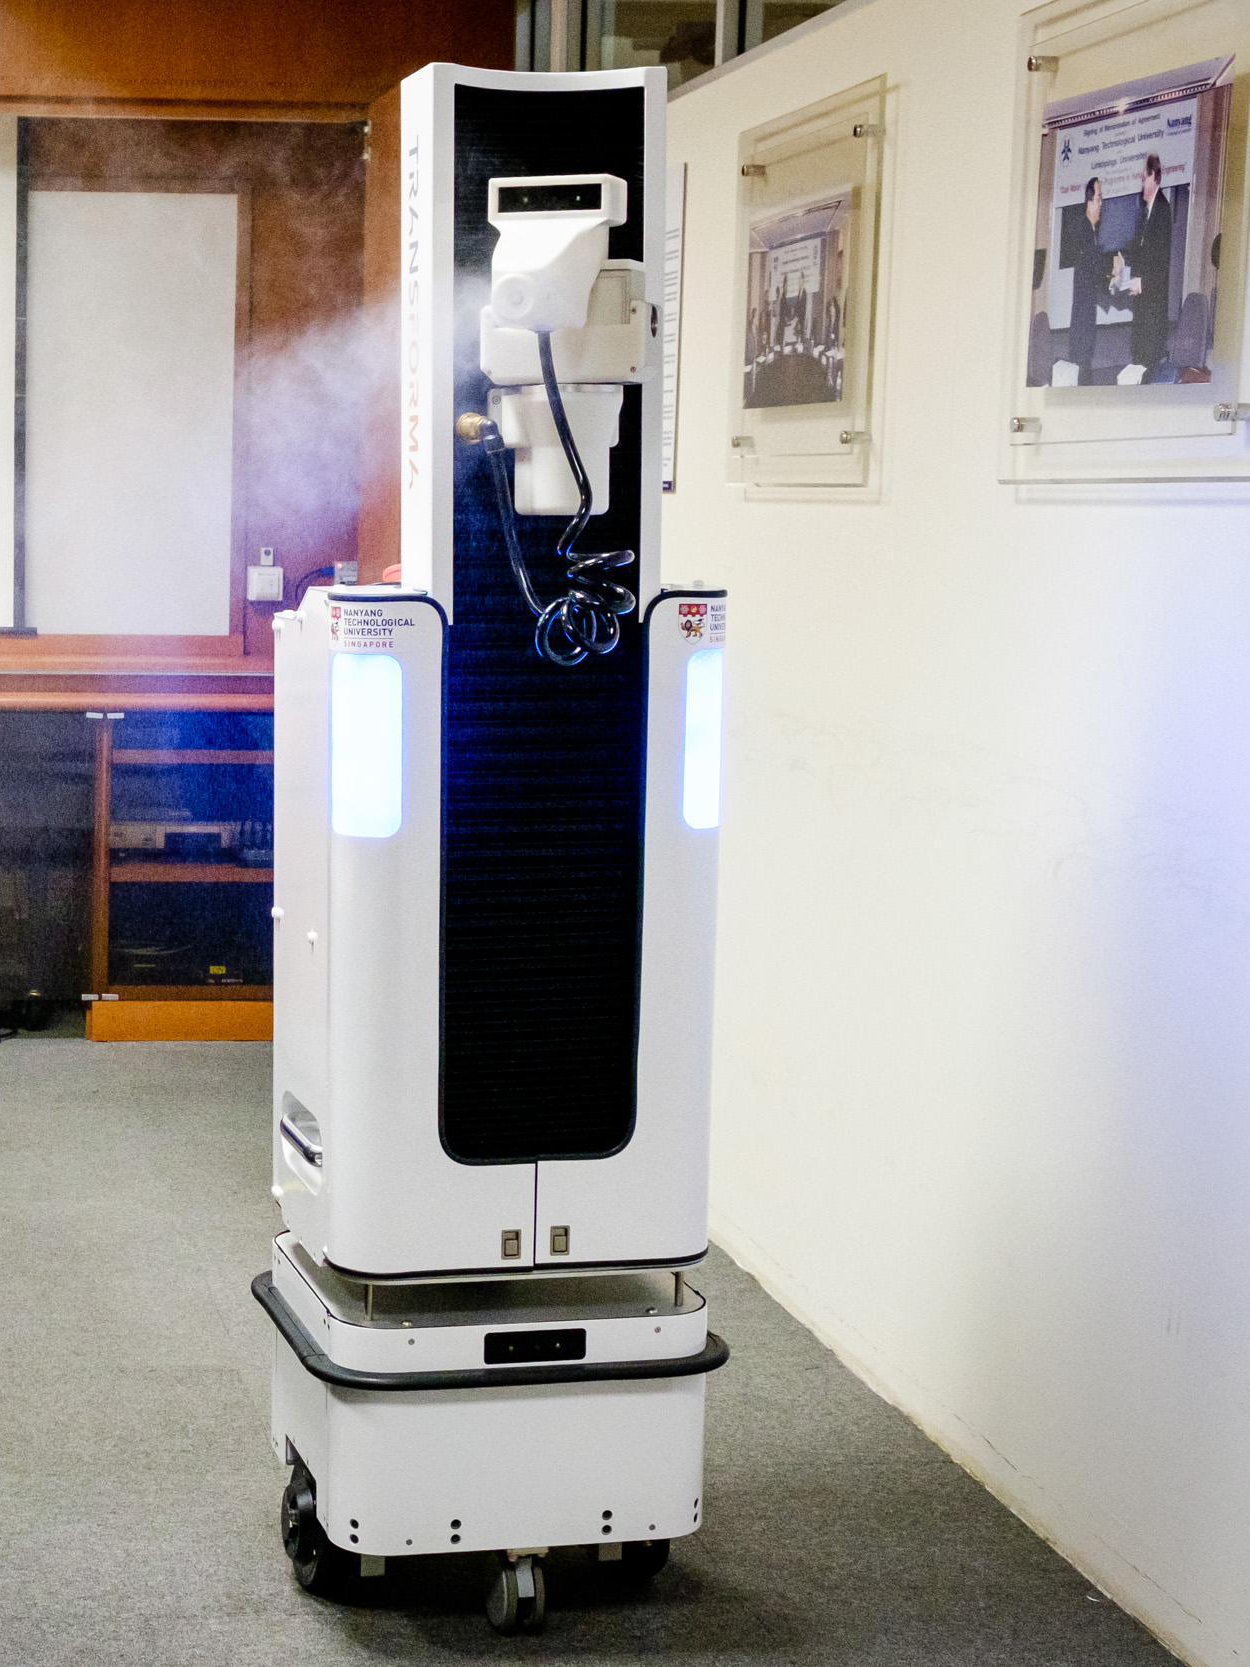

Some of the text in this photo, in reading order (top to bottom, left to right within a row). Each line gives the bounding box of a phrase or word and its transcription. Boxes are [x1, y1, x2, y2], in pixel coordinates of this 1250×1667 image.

[1102, 135, 1136, 150] Technological
[1137, 129, 1165, 142] University
[344, 609, 383, 617] NANYANG
[344, 618, 415, 626] TECHNOLOGICAL
[344, 628, 393, 636] UNIVERSITY
